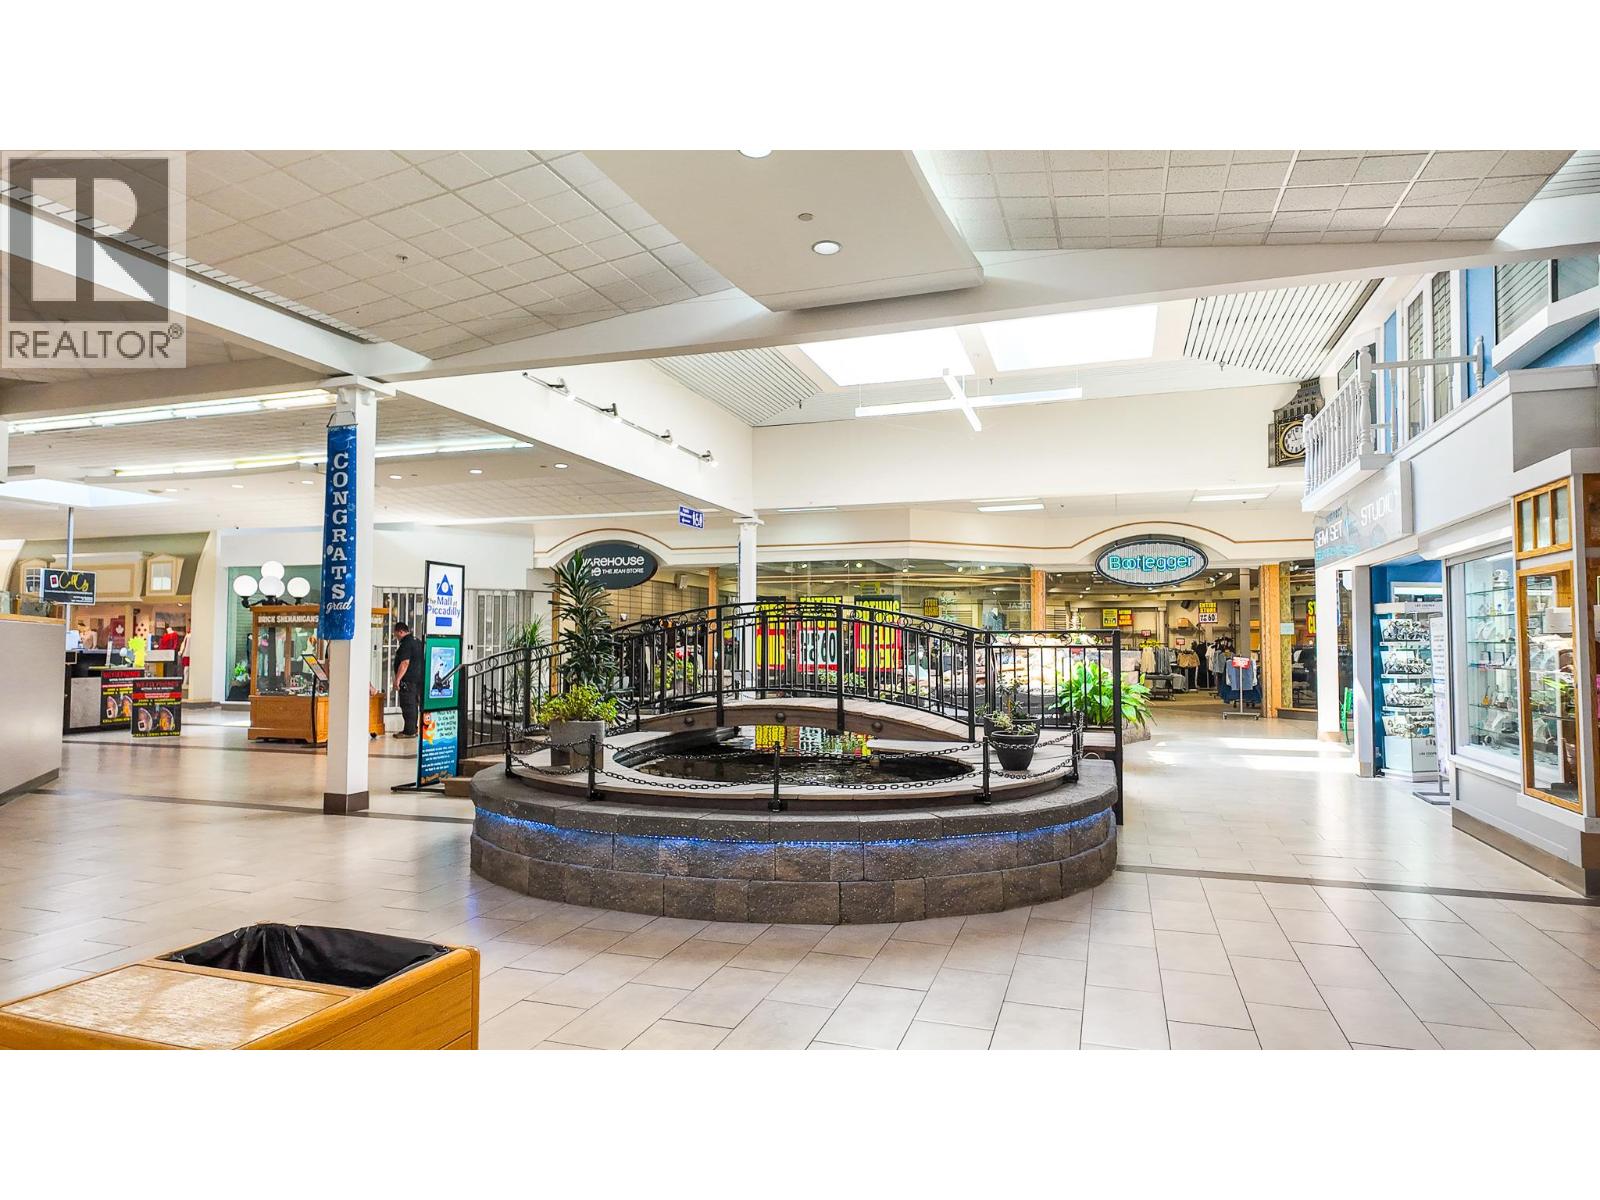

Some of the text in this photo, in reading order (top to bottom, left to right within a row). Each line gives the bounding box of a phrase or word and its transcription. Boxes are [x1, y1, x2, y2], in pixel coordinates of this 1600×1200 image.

[331, 452, 349, 600] CONGRATS
[1330, 519, 1343, 541] SET
[326, 596, 353, 615] grad
[437, 596, 452, 606] Mall
[427, 604, 460, 618] Piccadilly
[258, 615, 319, 624] BRICK SHENANIGANS
